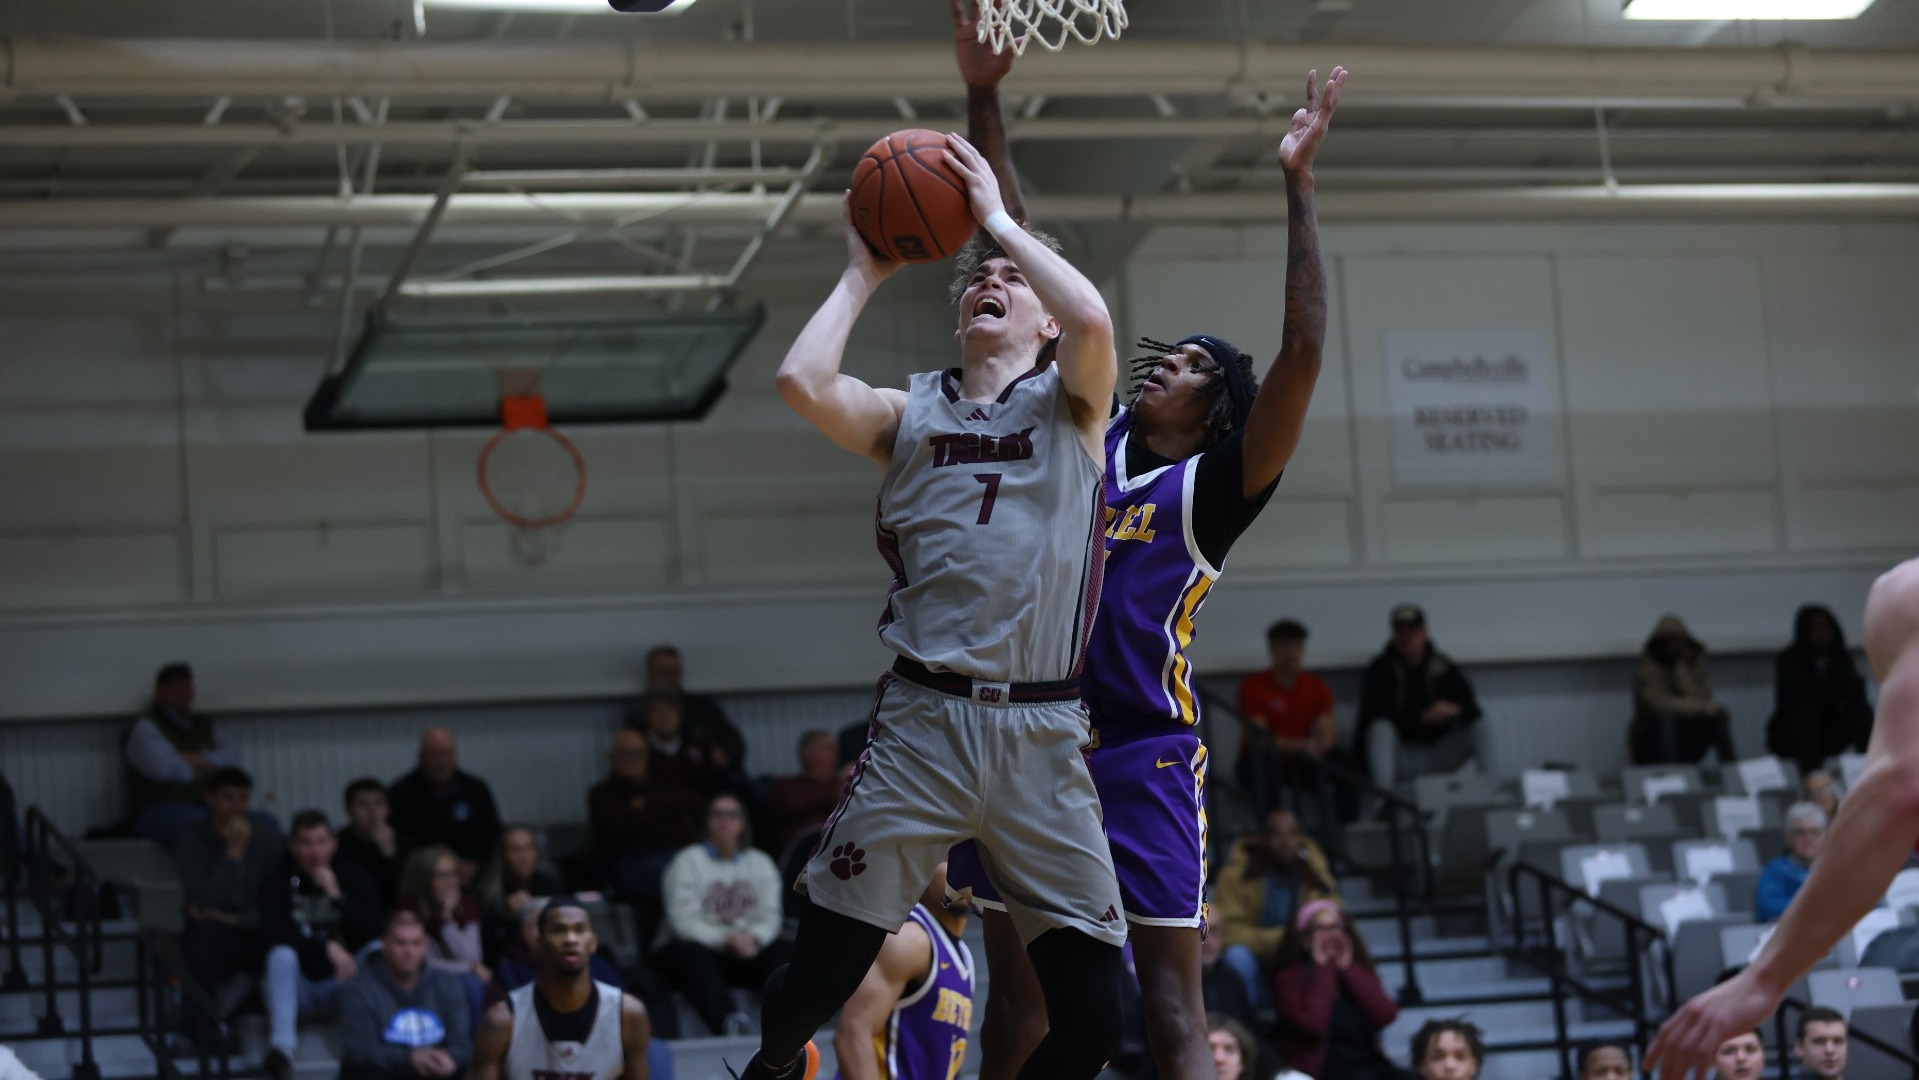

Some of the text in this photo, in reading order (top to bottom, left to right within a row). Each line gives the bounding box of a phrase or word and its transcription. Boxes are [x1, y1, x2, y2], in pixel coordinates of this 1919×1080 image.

[1413, 406, 1528, 426] RESERVED
[929, 425, 1036, 469] TIGERS
[1423, 431, 1522, 452] SEATING
[973, 473, 1003, 525] 7
